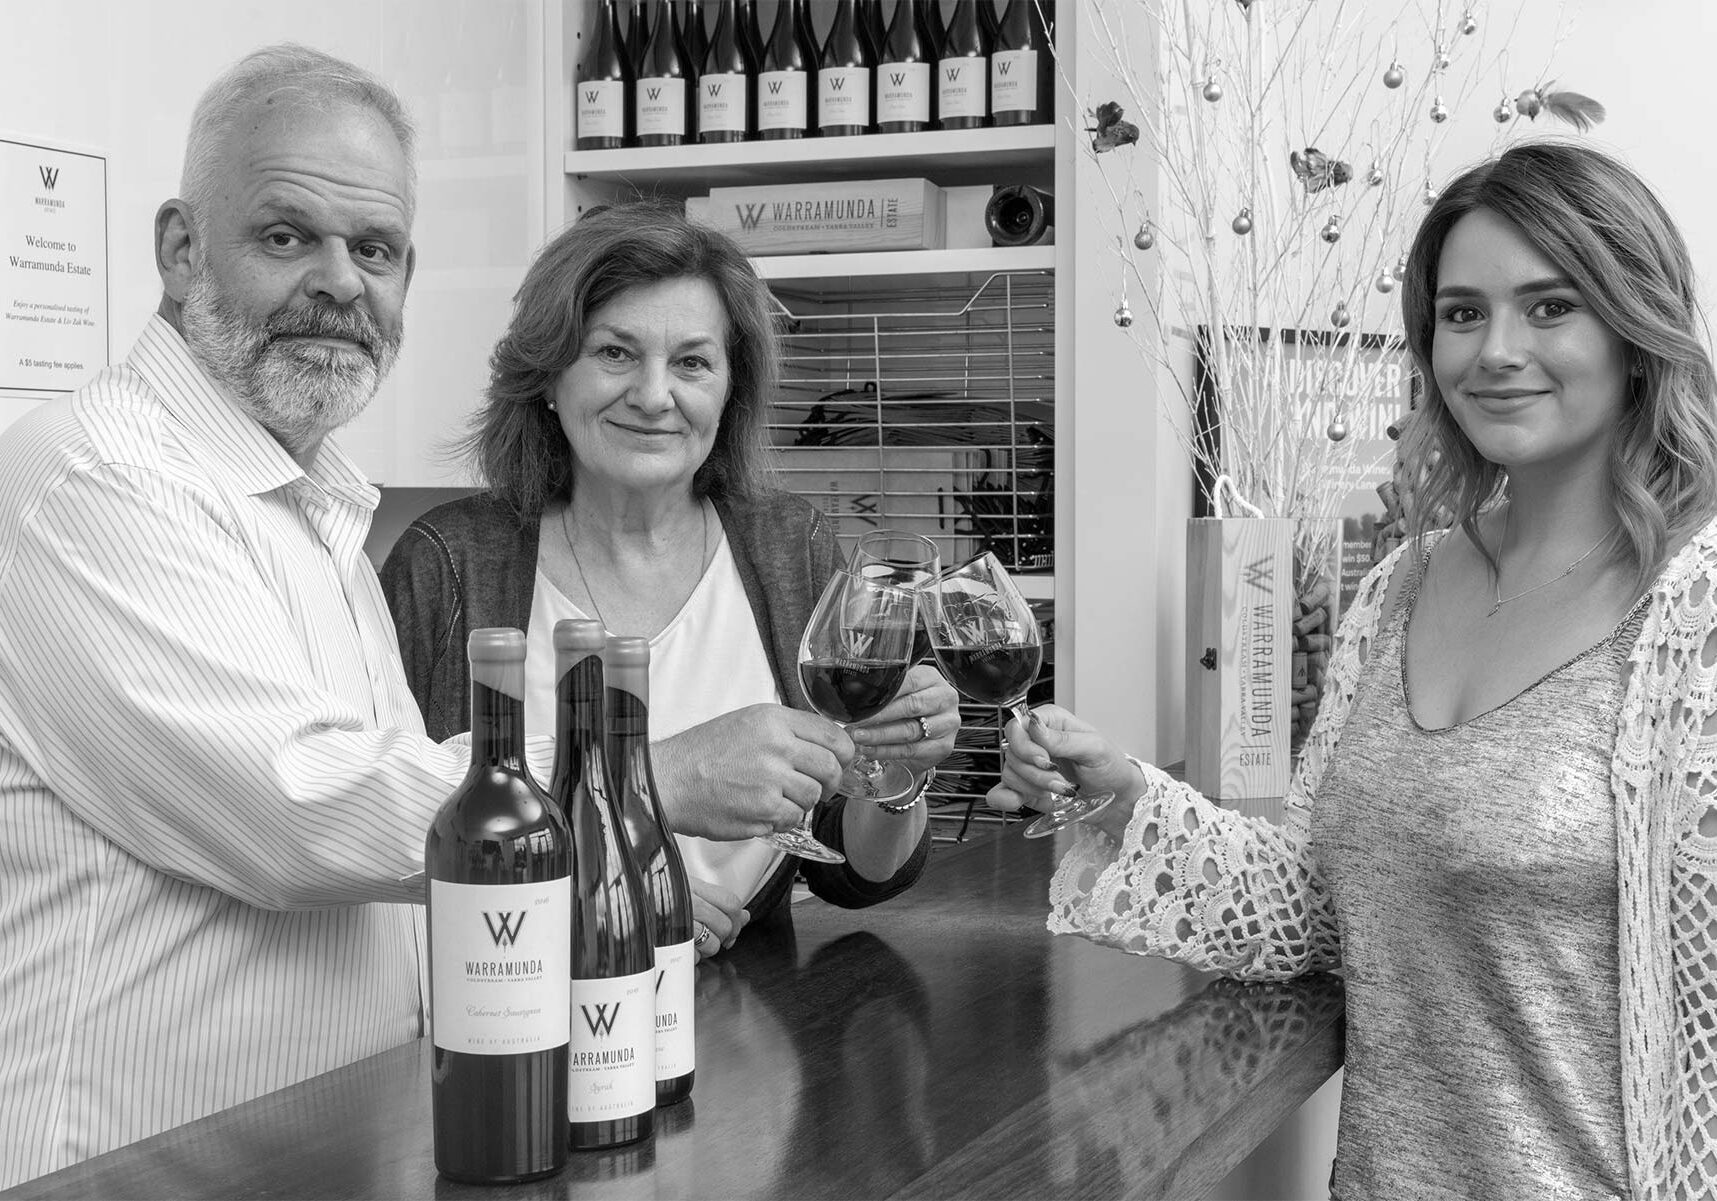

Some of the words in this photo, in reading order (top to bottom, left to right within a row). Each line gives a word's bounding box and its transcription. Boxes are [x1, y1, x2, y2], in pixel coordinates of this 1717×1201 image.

[773, 199, 876, 221] WARRAMUNDA
[887, 197, 898, 228] ESTATE
[25, 235, 66, 252] Welcome
[67, 242, 76, 252] to
[9, 256, 65, 273] Warramunda
[67, 265, 91, 276] Estate
[13, 300, 29, 310] Enjoy
[19, 358, 24, 366] A
[24, 358, 33, 367] $5
[33, 360, 52, 370] tasting
[53, 360, 63, 369] fee
[1343, 540, 1372, 550] member
[1342, 553, 1355, 562] win
[1252, 604, 1274, 738] WARRAMUNDA
[1239, 752, 1271, 767] ESTATE
[465, 959, 543, 977] WARRAMUNDA
[466, 1005, 502, 1018] Cabernet
[502, 1005, 542, 1020] Sauvignon
[656, 1012, 678, 1027] UNDA
[571, 1047, 635, 1066] ARRAMUNDA
